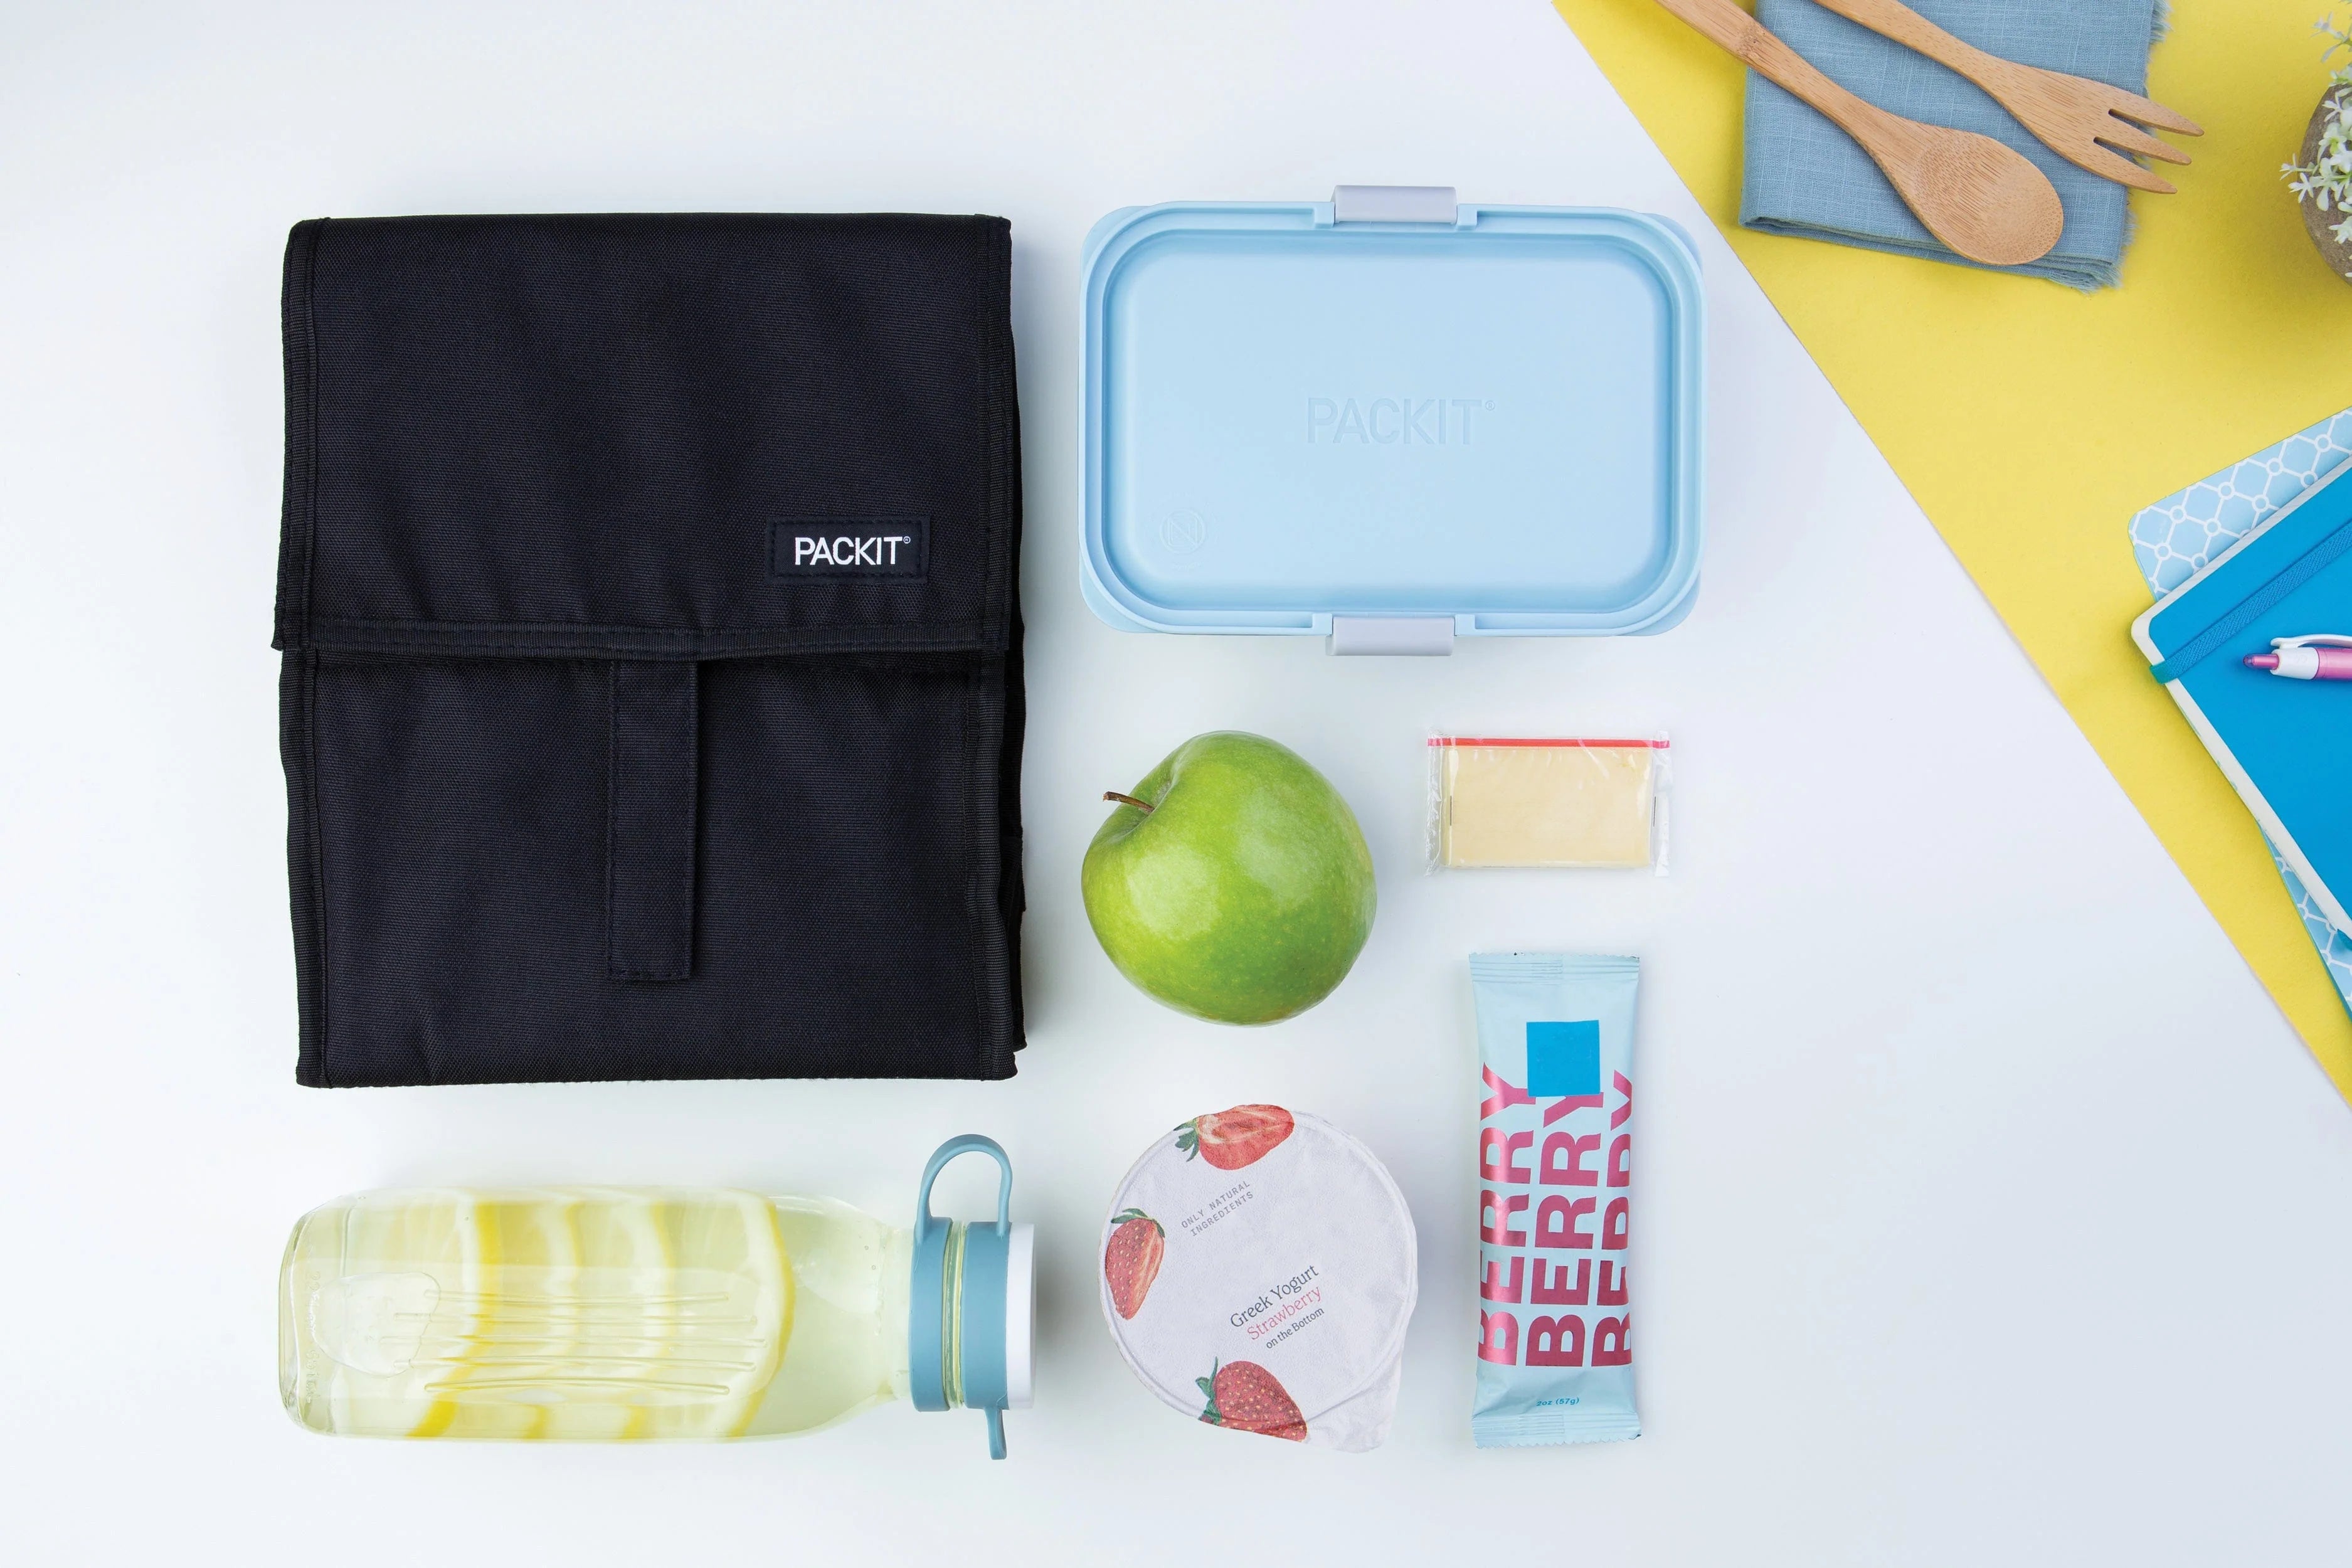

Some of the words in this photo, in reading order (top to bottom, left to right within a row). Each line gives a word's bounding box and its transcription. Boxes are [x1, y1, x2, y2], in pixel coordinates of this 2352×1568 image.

[1181, 1209, 1204, 1229] ONLY
[1209, 1180, 1250, 1210] NATURAL
[1190, 1191, 1254, 1237] INGREDIENTS
[1478, 1061, 1537, 1366] BERRY
[1230, 1296, 1273, 1327] Greek
[1269, 1264, 1319, 1300] Yogurt
[1247, 1286, 1322, 1340] Strawberry
[1266, 1338, 1278, 1349] on
[1278, 1328, 1293, 1342] the
[1291, 1308, 1325, 1332] Bottom
[1555, 1396, 1580, 1406] (57g)
